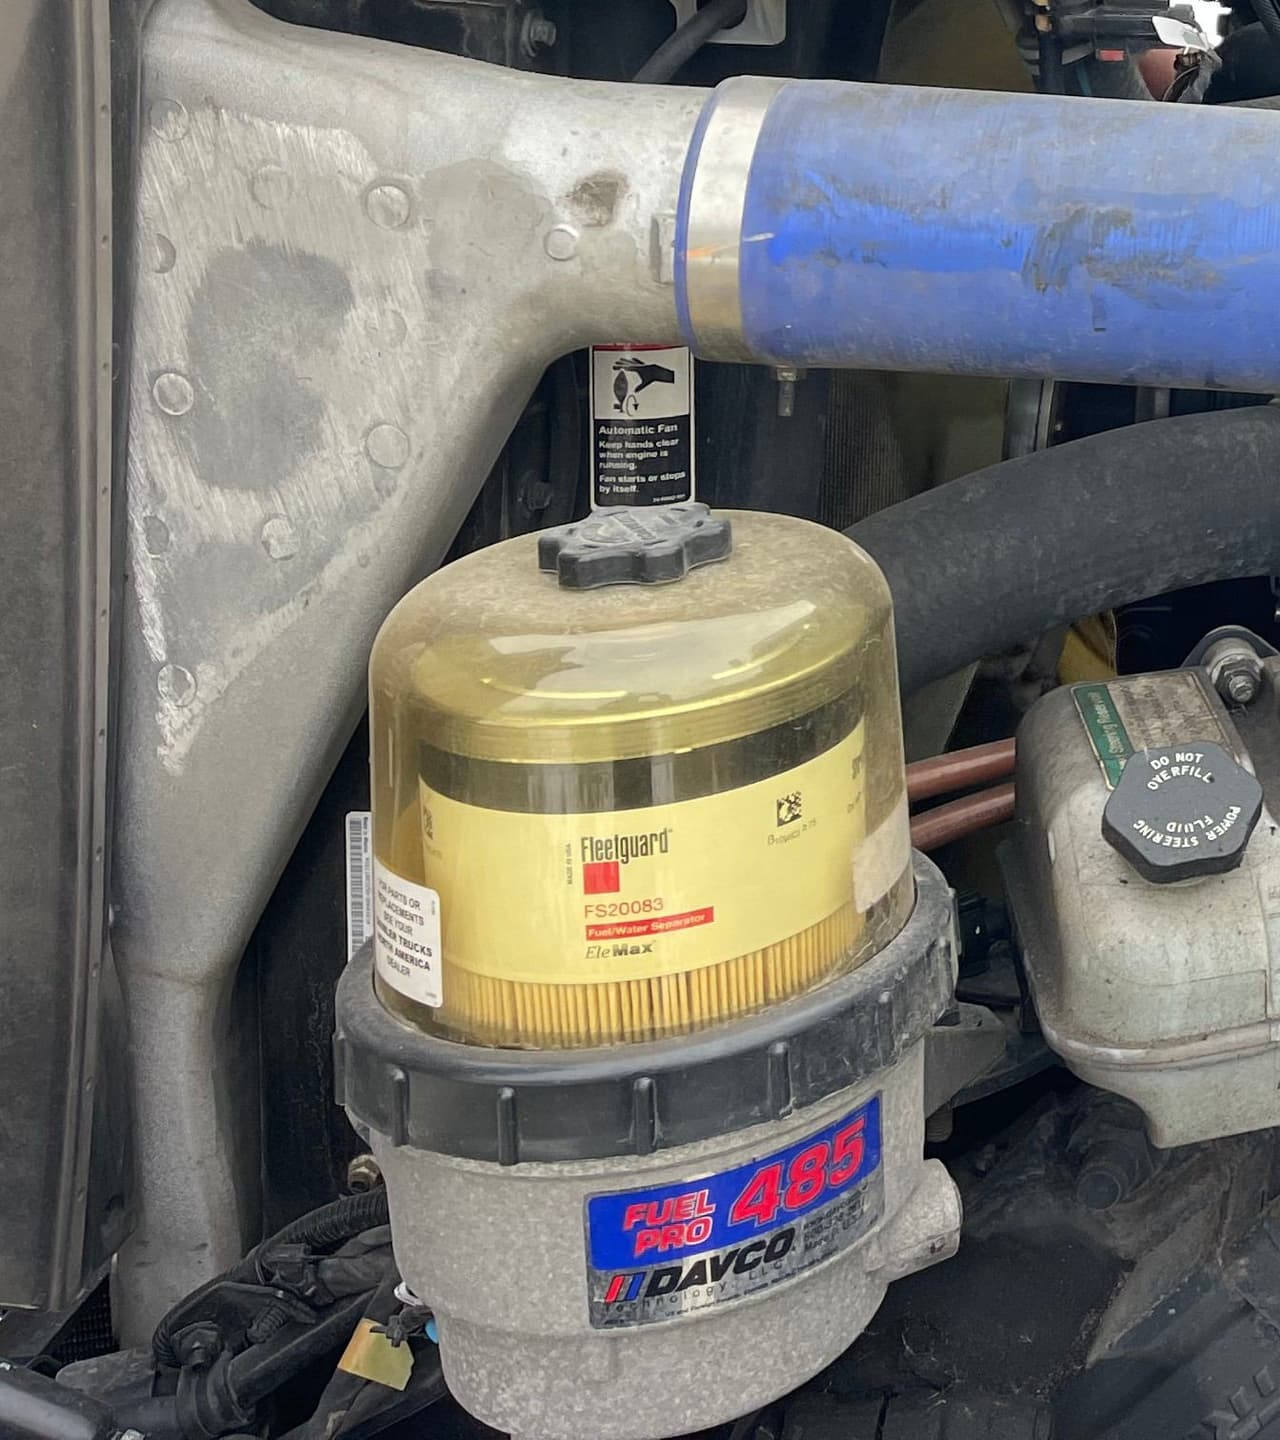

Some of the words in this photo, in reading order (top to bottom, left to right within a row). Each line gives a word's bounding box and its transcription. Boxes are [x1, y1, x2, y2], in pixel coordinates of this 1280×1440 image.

[599, 425, 655, 435] Automatic
[657, 424, 678, 433] Fan
[599, 440, 623, 449] Keep
[656, 439, 679, 448] clear
[599, 451, 624, 459] when
[625, 451, 658, 460] engine
[599, 474, 616, 482] Fan
[618, 474, 646, 483] starts
[648, 474, 658, 482] or
[660, 471, 686, 481] stops
[599, 485, 611, 494] by
[1150, 756, 1170, 770] DO
[1175, 752, 1204, 763] NOT
[1147, 765, 1212, 791] OVERFILL
[1133, 819, 1199, 848] STEERING
[1166, 815, 1214, 833] FLUID
[1205, 805, 1241, 841] POWER
[581, 828, 669, 864] Fleetguard
[387, 887, 408, 906] PARTS
[408, 898, 421, 911] OR
[584, 897, 664, 919] FS20083
[588, 924, 649, 938] Fuel/Water
[651, 914, 706, 931] Separator
[399, 935, 433, 957] TRUCKS
[394, 947, 431, 971] AMERICA
[623, 1188, 716, 1231] FUEL
[727, 1114, 866, 1228] 485
[633, 1217, 714, 1258] PRO
[645, 1227, 796, 1298] DAVCO
